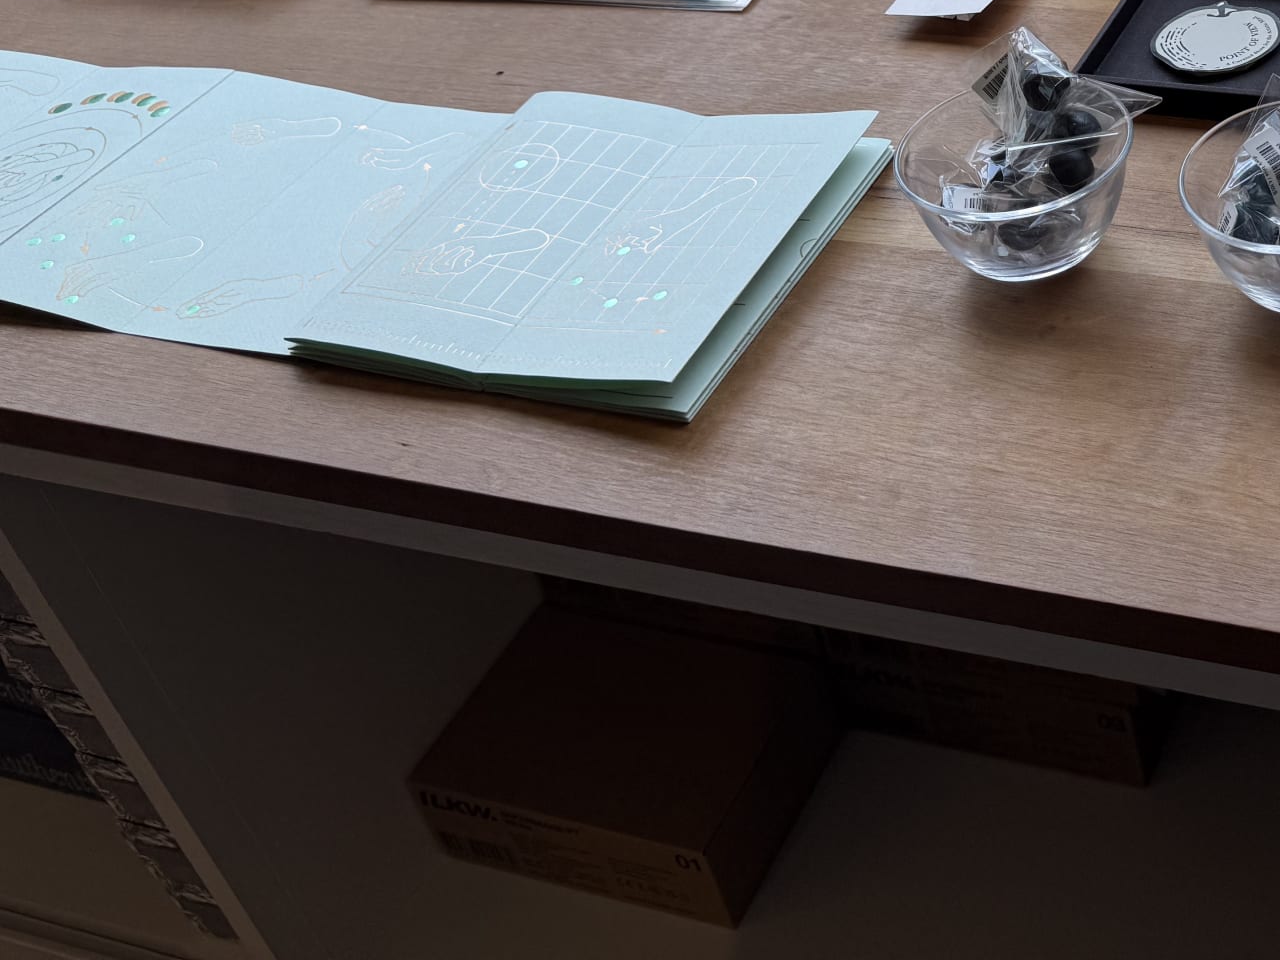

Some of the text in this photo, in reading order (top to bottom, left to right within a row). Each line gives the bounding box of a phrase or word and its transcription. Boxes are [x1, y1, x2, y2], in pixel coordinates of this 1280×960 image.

[1219, 22, 1260, 62] POINT OF VIEW
[420, 790, 498, 823] ILKW.
